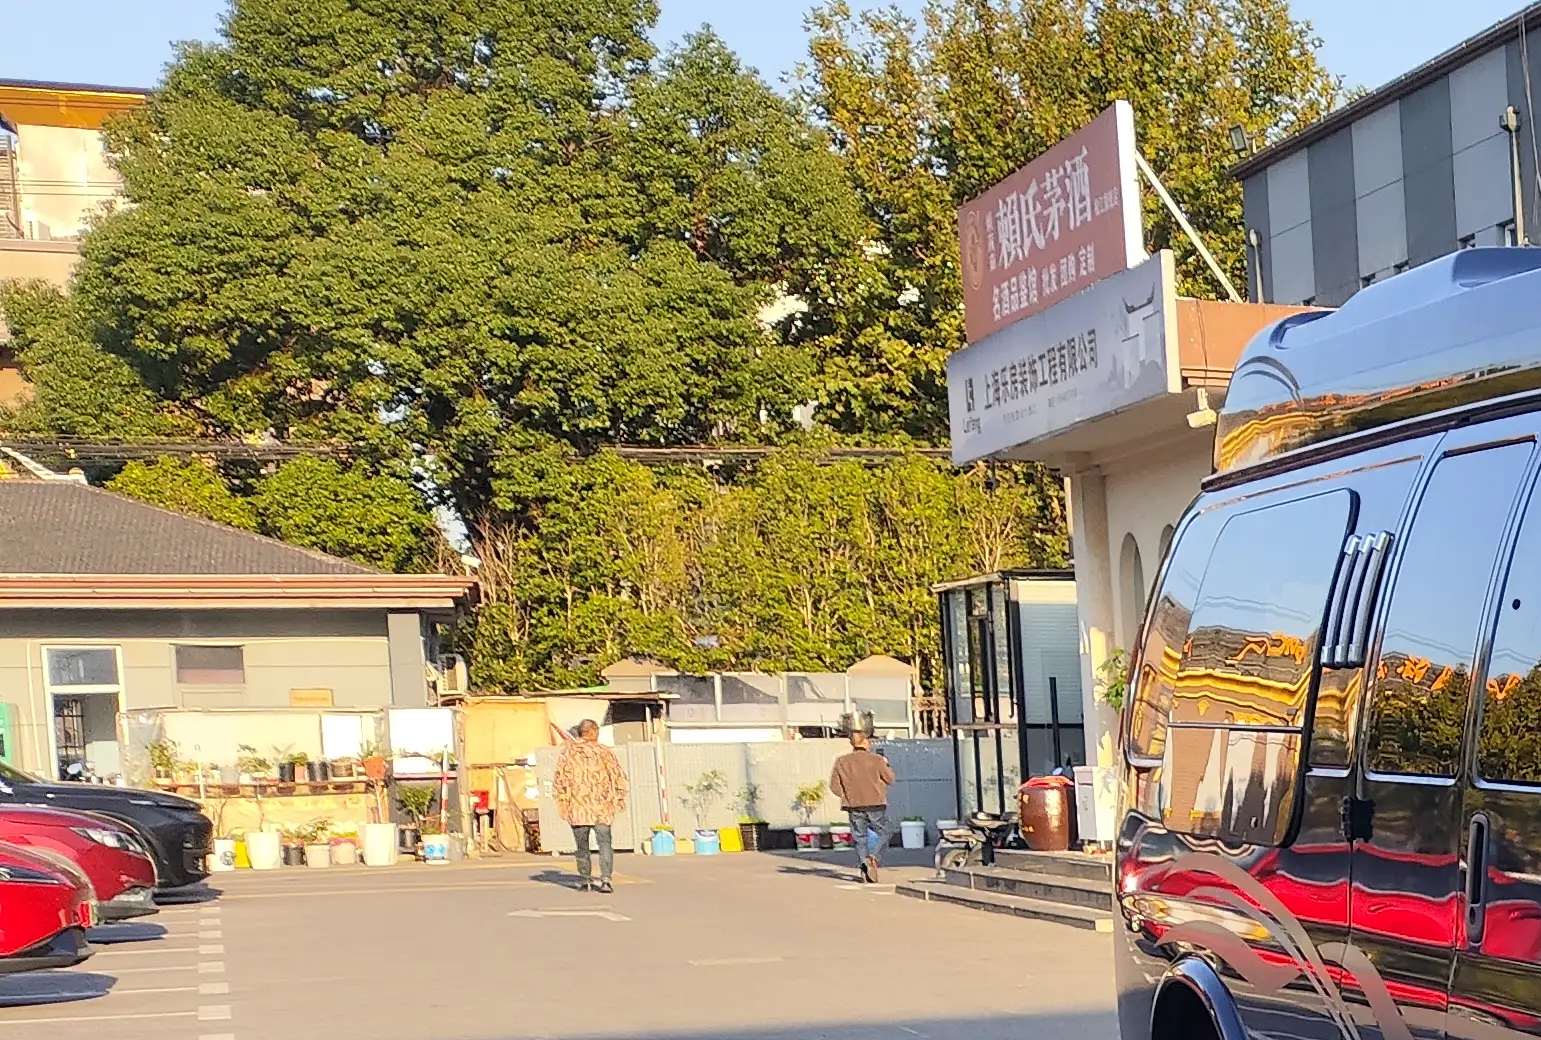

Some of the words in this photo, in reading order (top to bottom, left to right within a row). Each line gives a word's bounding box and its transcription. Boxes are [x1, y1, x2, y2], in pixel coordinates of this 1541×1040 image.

[996, 145, 1092, 269] 賴氏茅酒
[1078, 241, 1096, 277] 定制
[984, 328, 1099, 411] 上海乐房装饰工程有限公司
